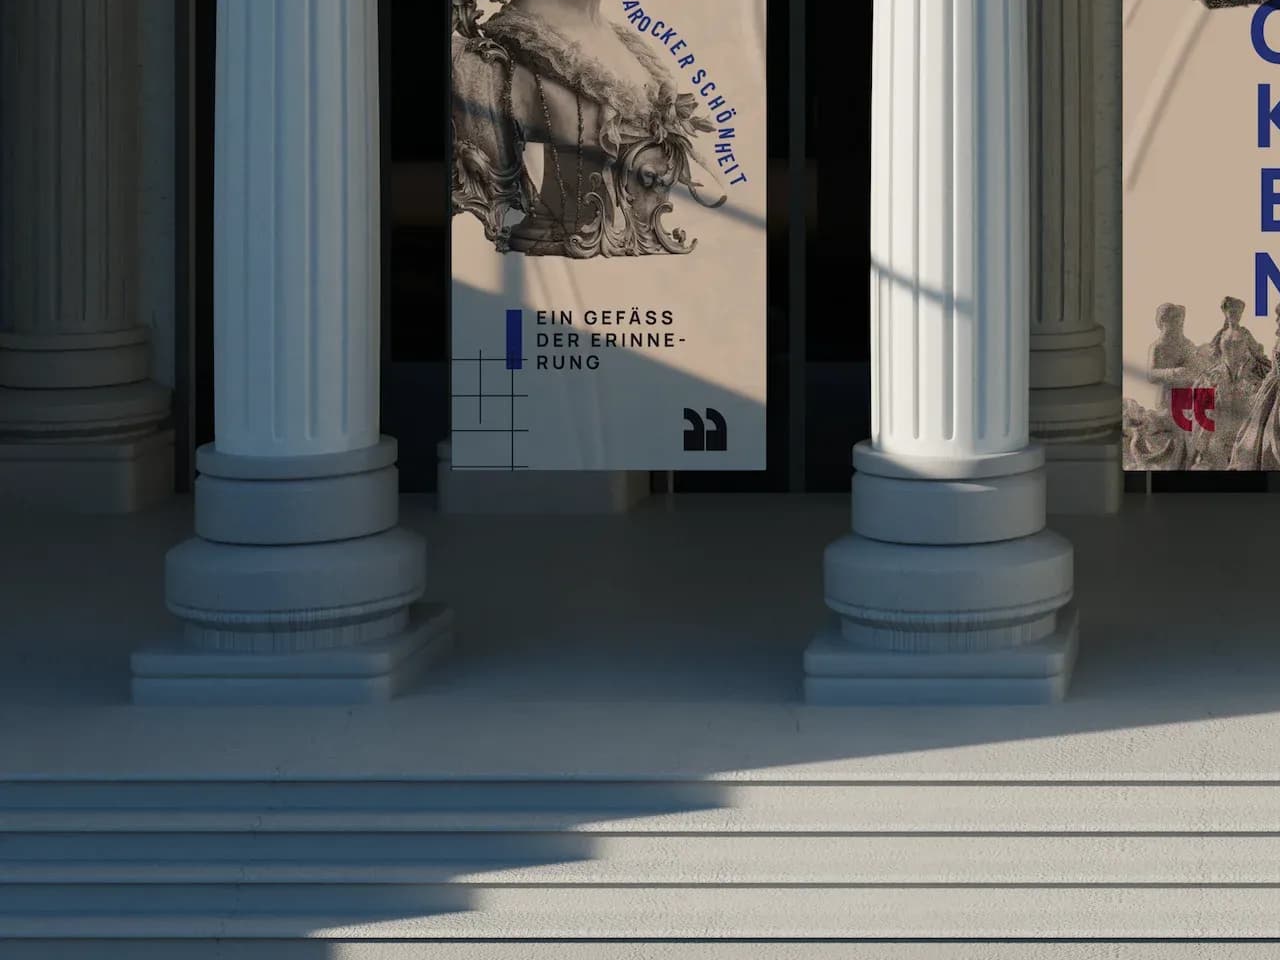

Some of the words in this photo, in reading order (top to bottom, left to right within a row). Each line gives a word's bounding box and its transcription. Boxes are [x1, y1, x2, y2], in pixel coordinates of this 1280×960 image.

[691, 68, 748, 187] SCHÖNHEIT
[535, 309, 573, 325] EIN
[583, 307, 674, 326] GEFÄSS
[535, 332, 580, 348] DER
[590, 332, 687, 348] ERINNE-
[535, 354, 601, 371] RUNG
